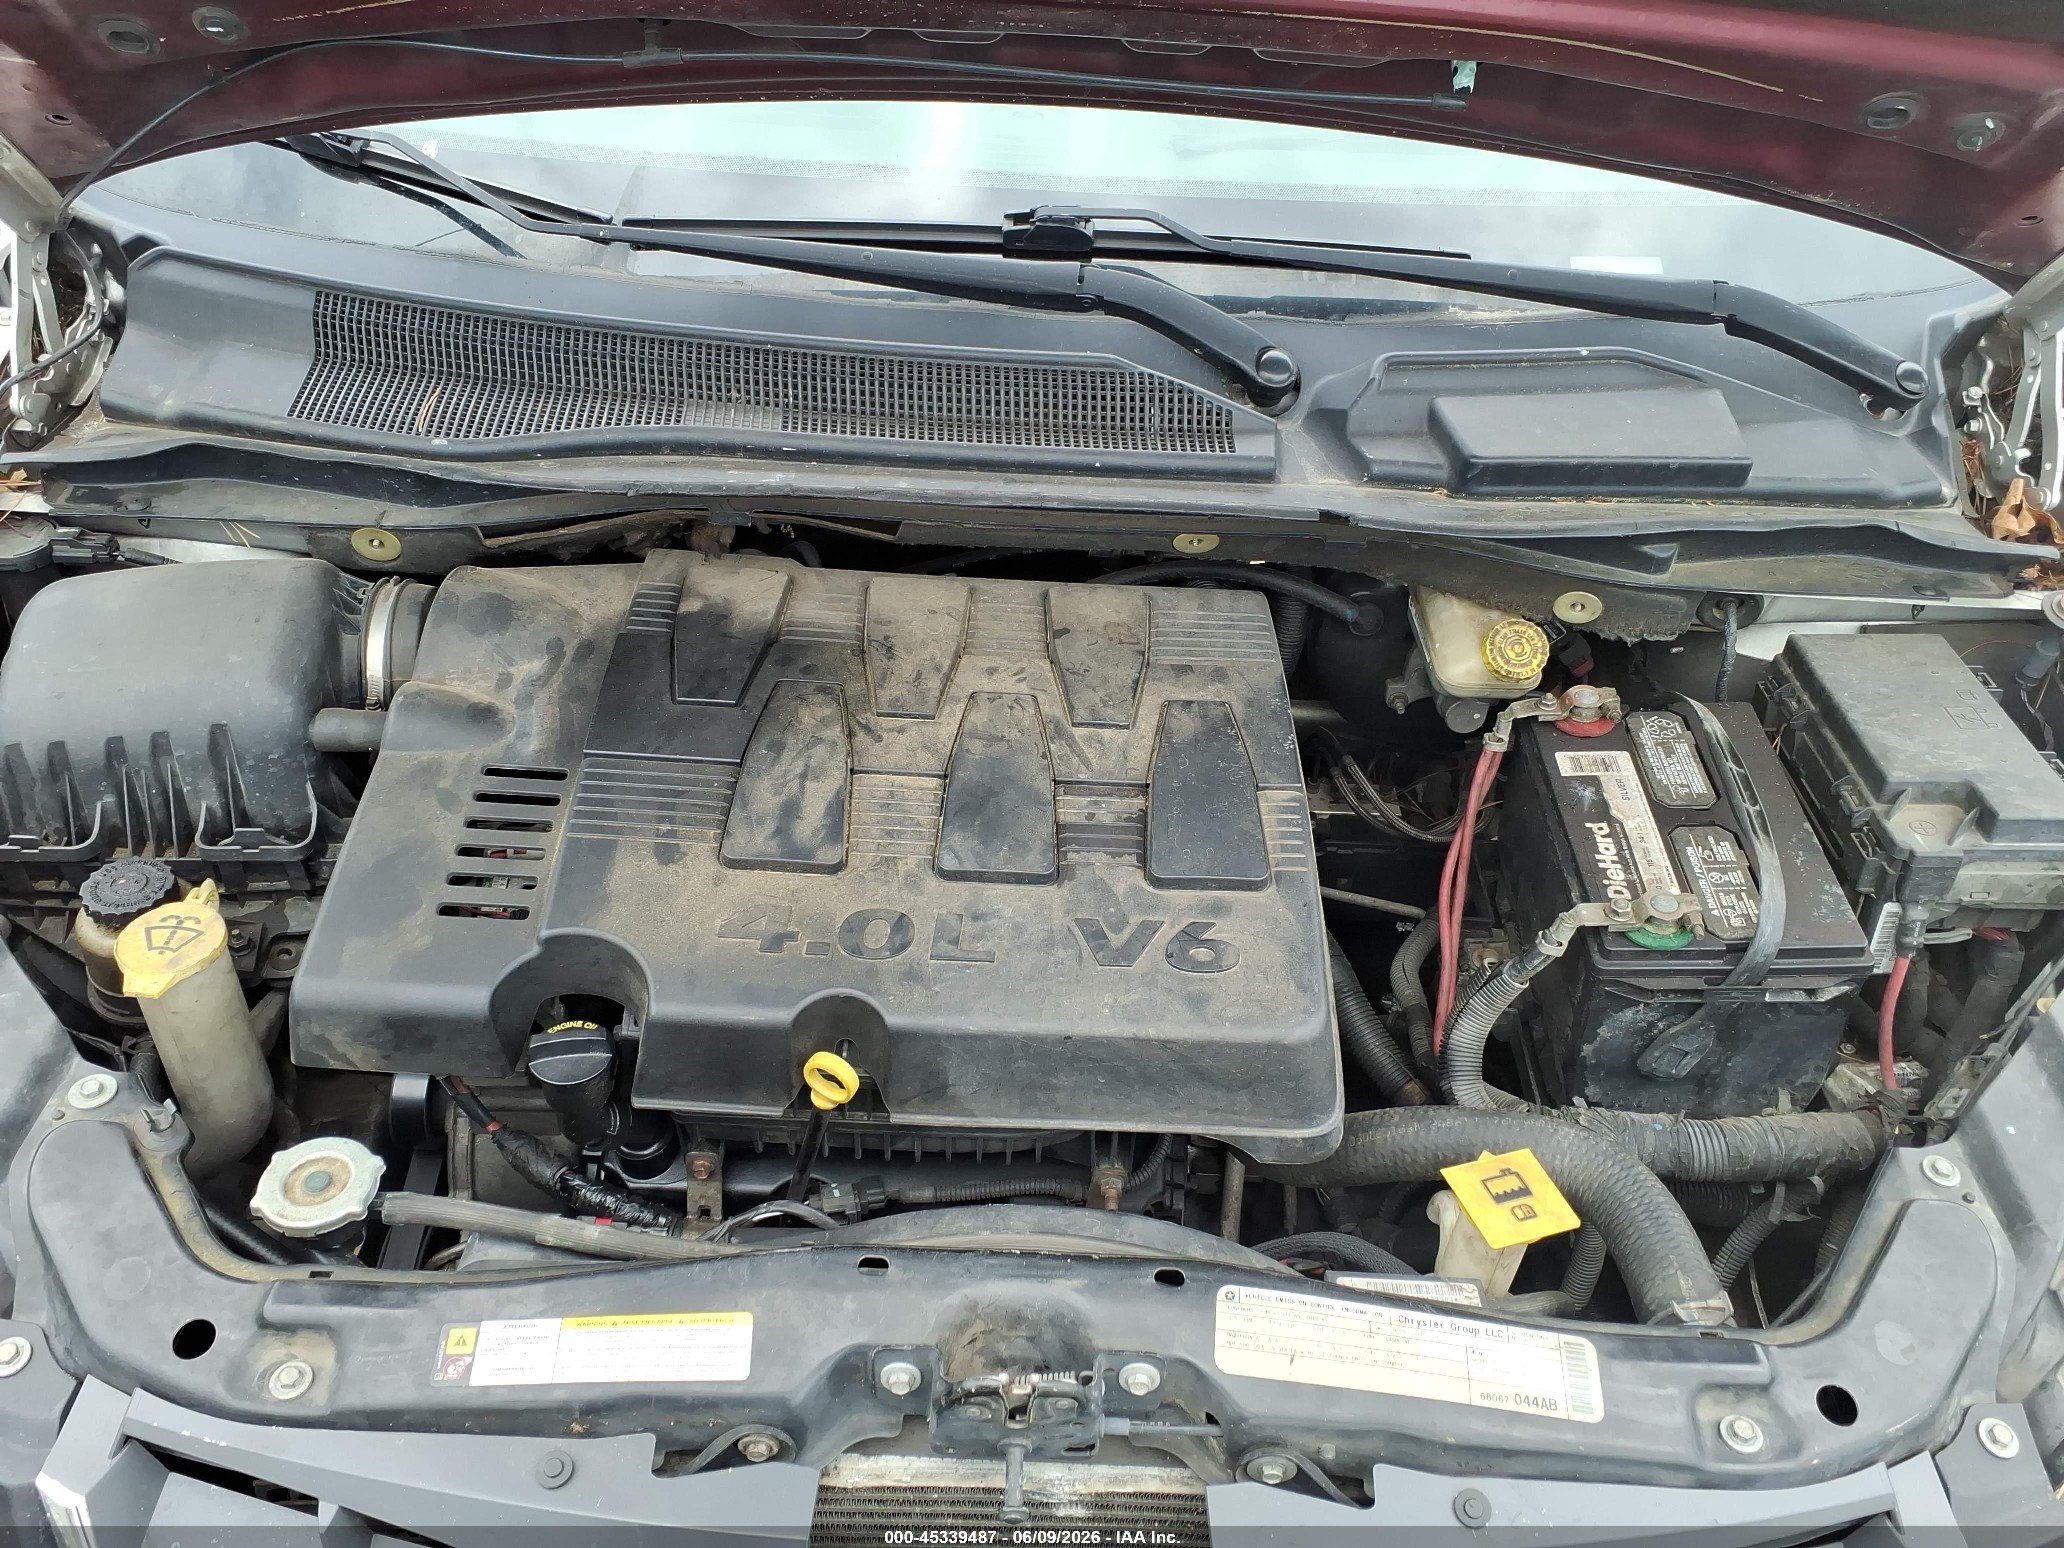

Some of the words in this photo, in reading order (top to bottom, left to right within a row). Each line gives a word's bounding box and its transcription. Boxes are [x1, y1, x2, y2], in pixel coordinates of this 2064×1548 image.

[1615, 778, 1630, 801] SILVER
[1584, 822, 1632, 900] DieHard
[1685, 846, 1703, 873] POISON
[1698, 879, 1718, 908] DANGER
[716, 904, 997, 964] 4.0L
[1073, 916, 1242, 974] V6
[546, 1020, 584, 1034] ENGINE
[1275, 1296, 1307, 1307] EMISSON
[1398, 1314, 1444, 1330] Chrysler
[1450, 1322, 1480, 1337] Group
[1485, 1327, 1504, 1339] LLC
[1514, 1393, 1558, 1411] 044AB
